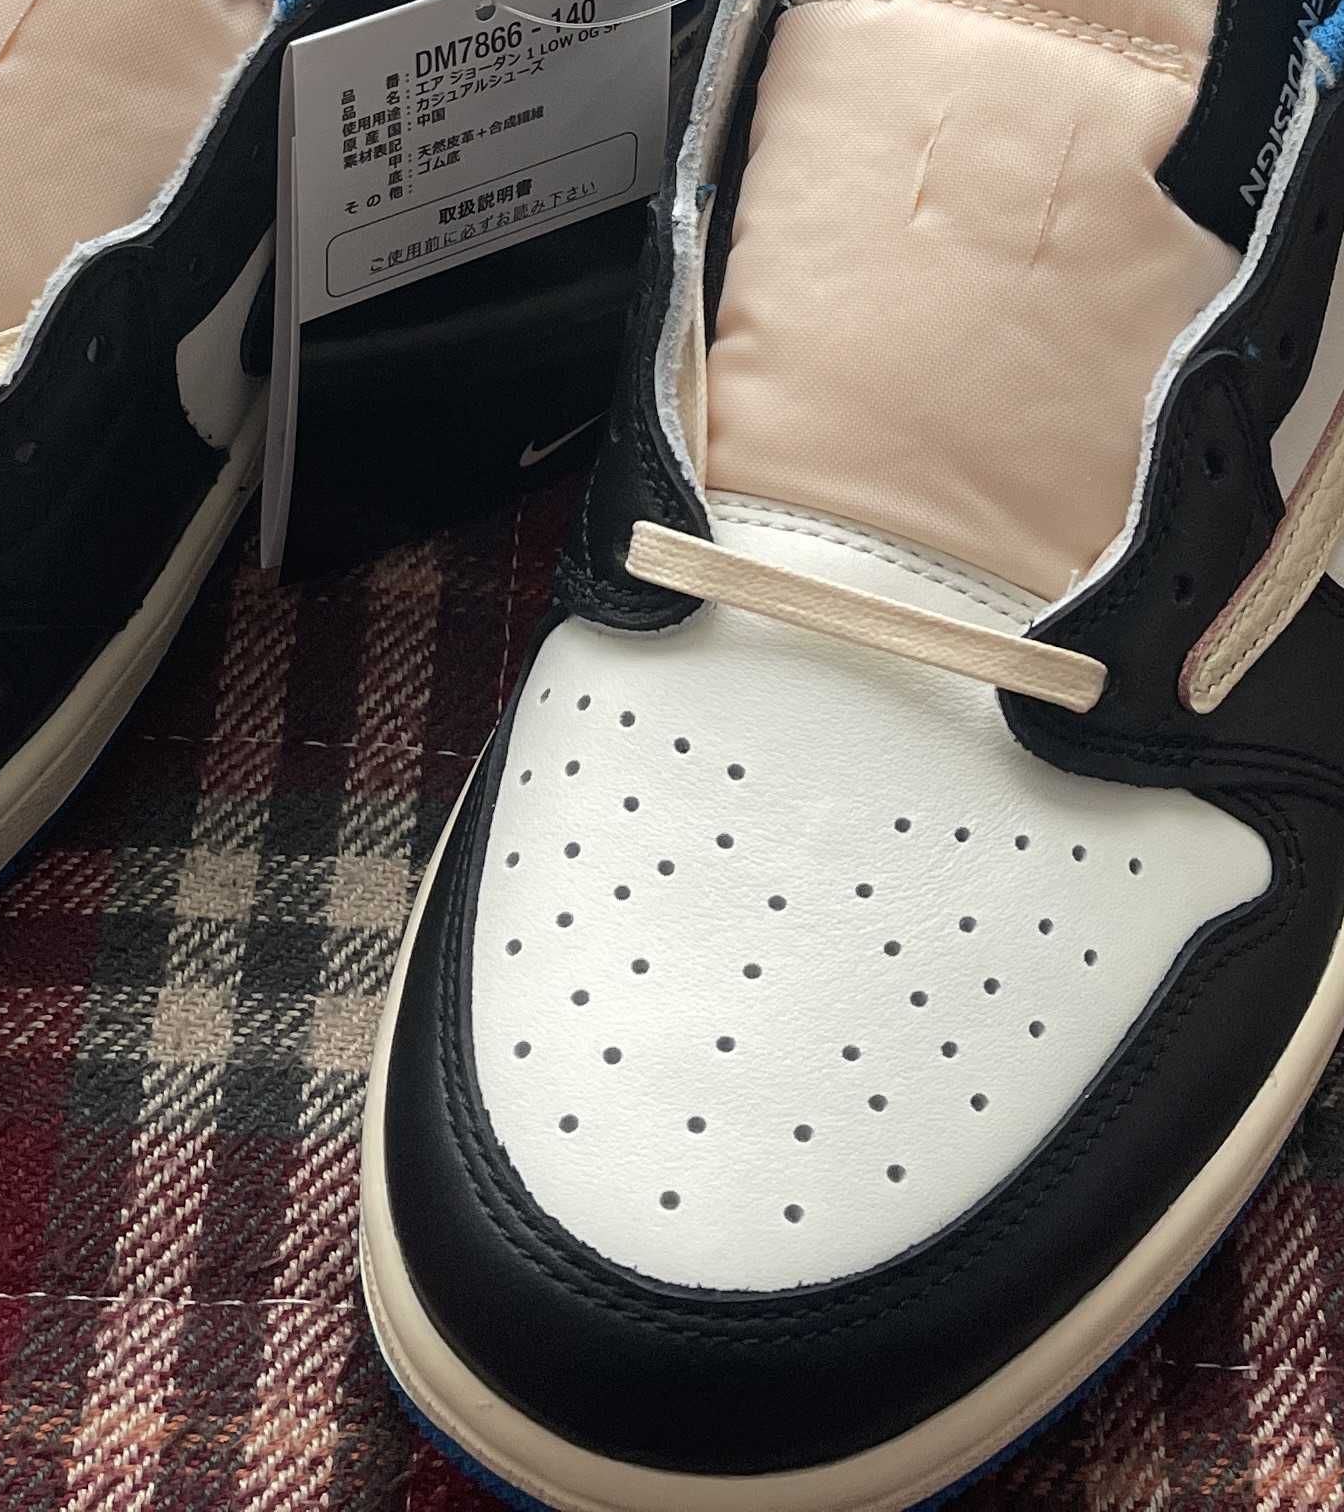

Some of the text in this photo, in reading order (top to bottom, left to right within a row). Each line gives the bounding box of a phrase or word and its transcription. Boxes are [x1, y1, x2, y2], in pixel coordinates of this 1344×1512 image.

[416, 21, 523, 79] DM7866
[527, 48, 535, 60] 1
[540, 34, 574, 55] LOW
[578, 28, 600, 42] OG
[416, 58, 545, 113] カジュアルシューズ
[417, 107, 446, 127] 中国
[438, 178, 534, 226] 取扱説明書
